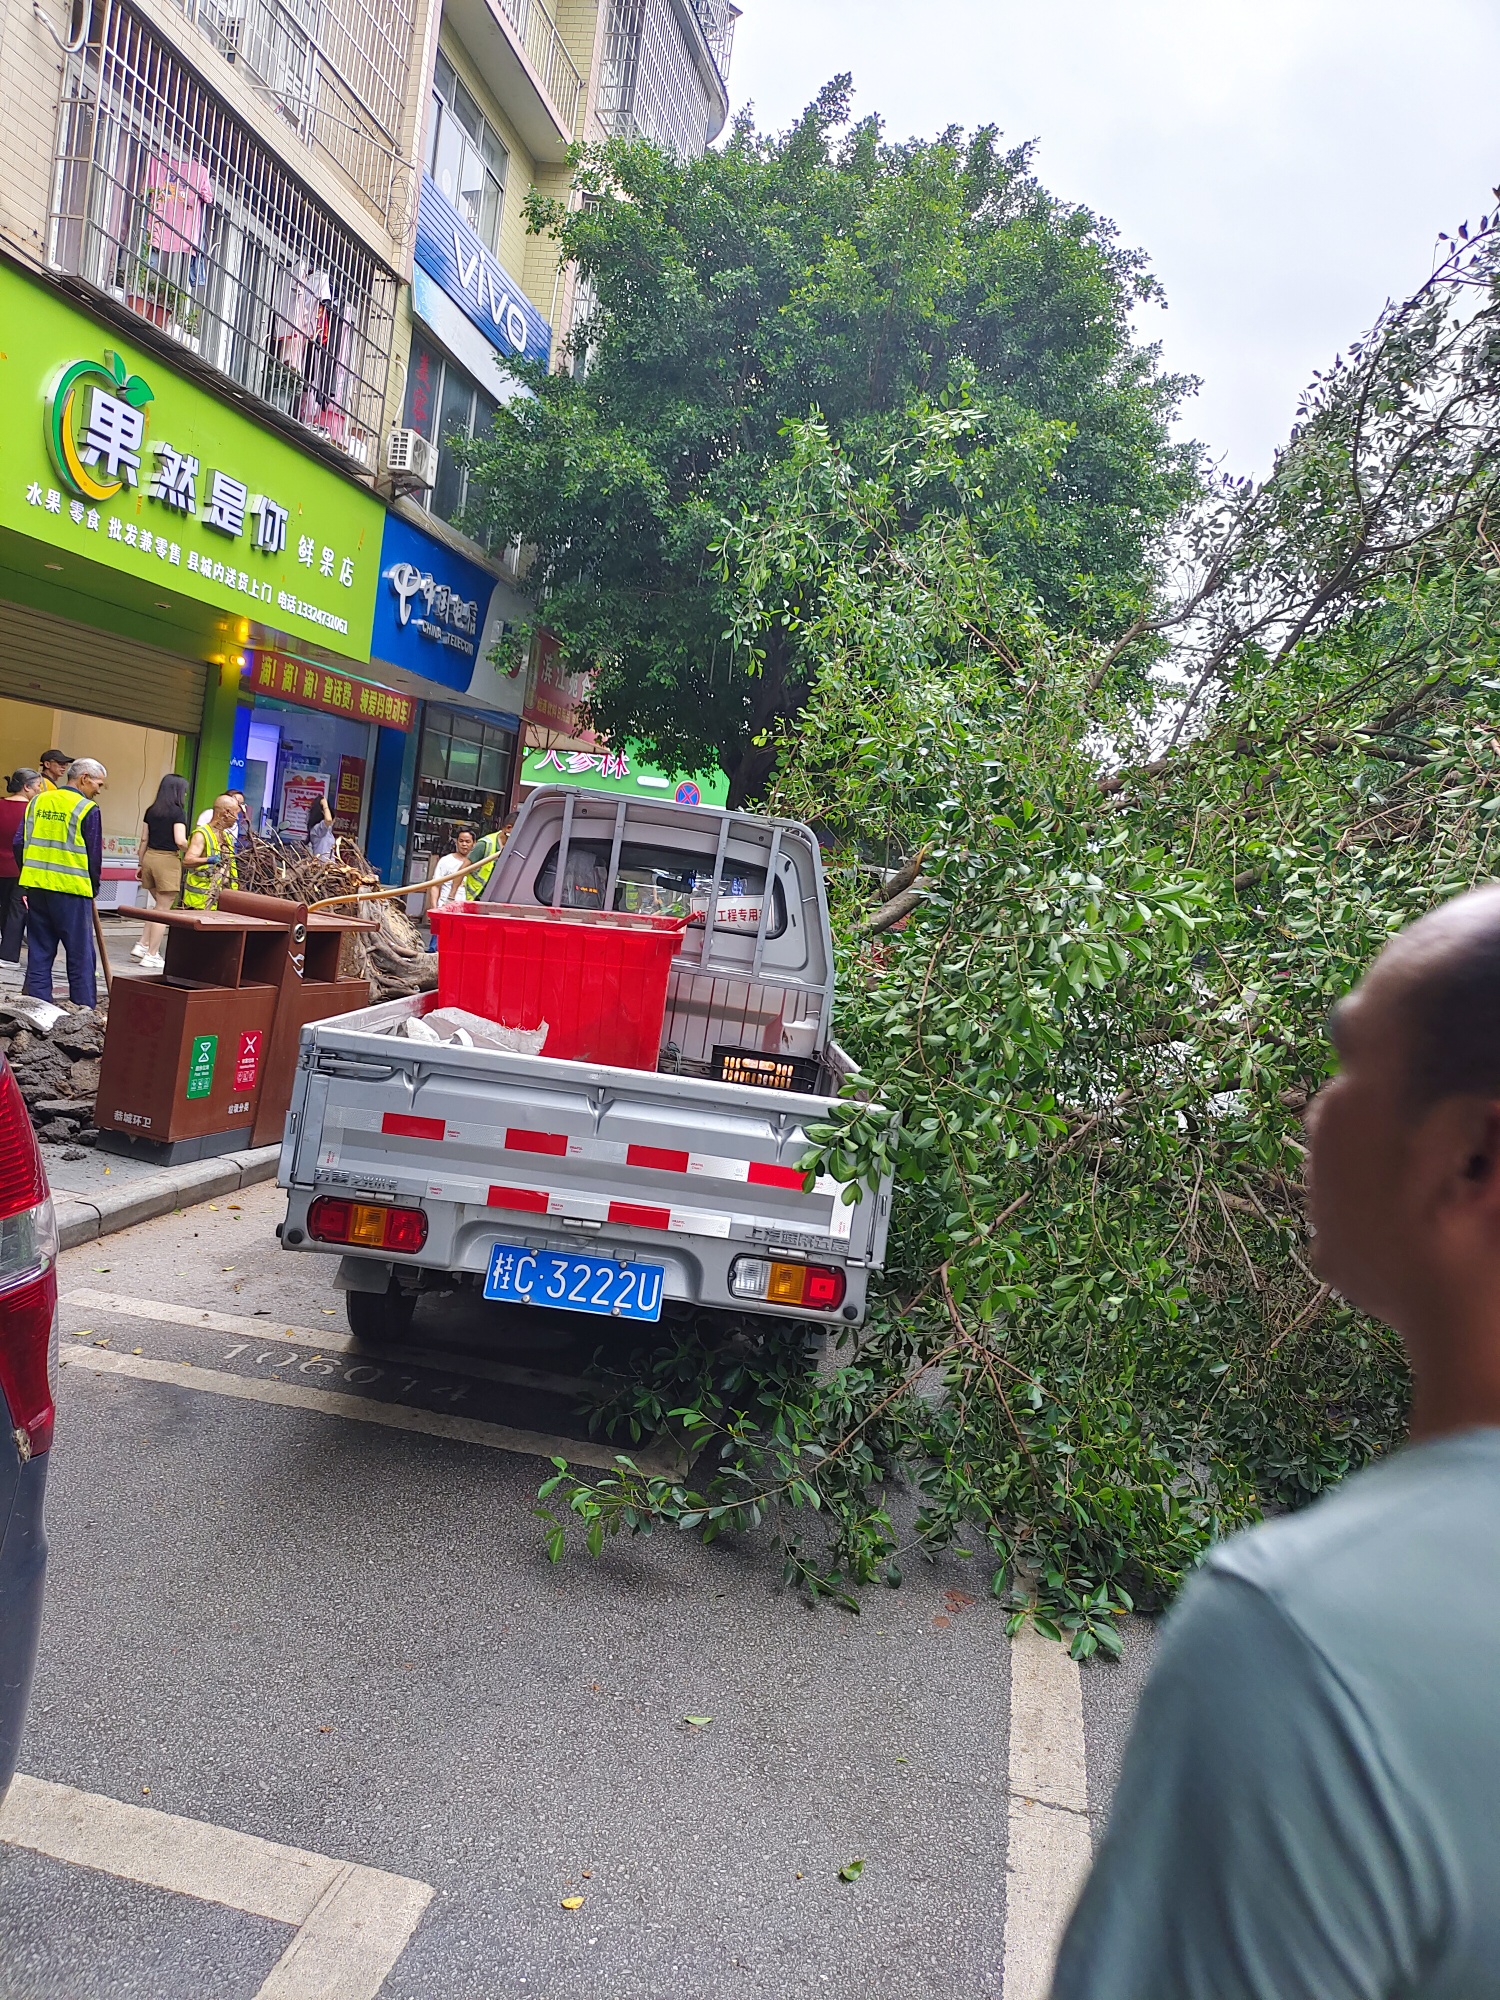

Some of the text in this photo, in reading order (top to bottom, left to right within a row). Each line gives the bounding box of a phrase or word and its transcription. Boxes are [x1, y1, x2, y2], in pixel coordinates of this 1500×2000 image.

[453, 230, 527, 353] vivo
[82, 385, 289, 553] 果然是你
[26, 482, 61, 514] 水果
[69, 499, 101, 532] 零食
[108, 516, 182, 566] 批发兼零售
[187, 549, 273, 604] 县城内送货上门
[298, 535, 355, 588] 鲜果店
[421, 573, 478, 635] 中国电信
[422, 621, 474, 656] CHINA TELECOM
[229, 756, 245, 768] vivo
[113, 1110, 151, 1129] 恭城环卫
